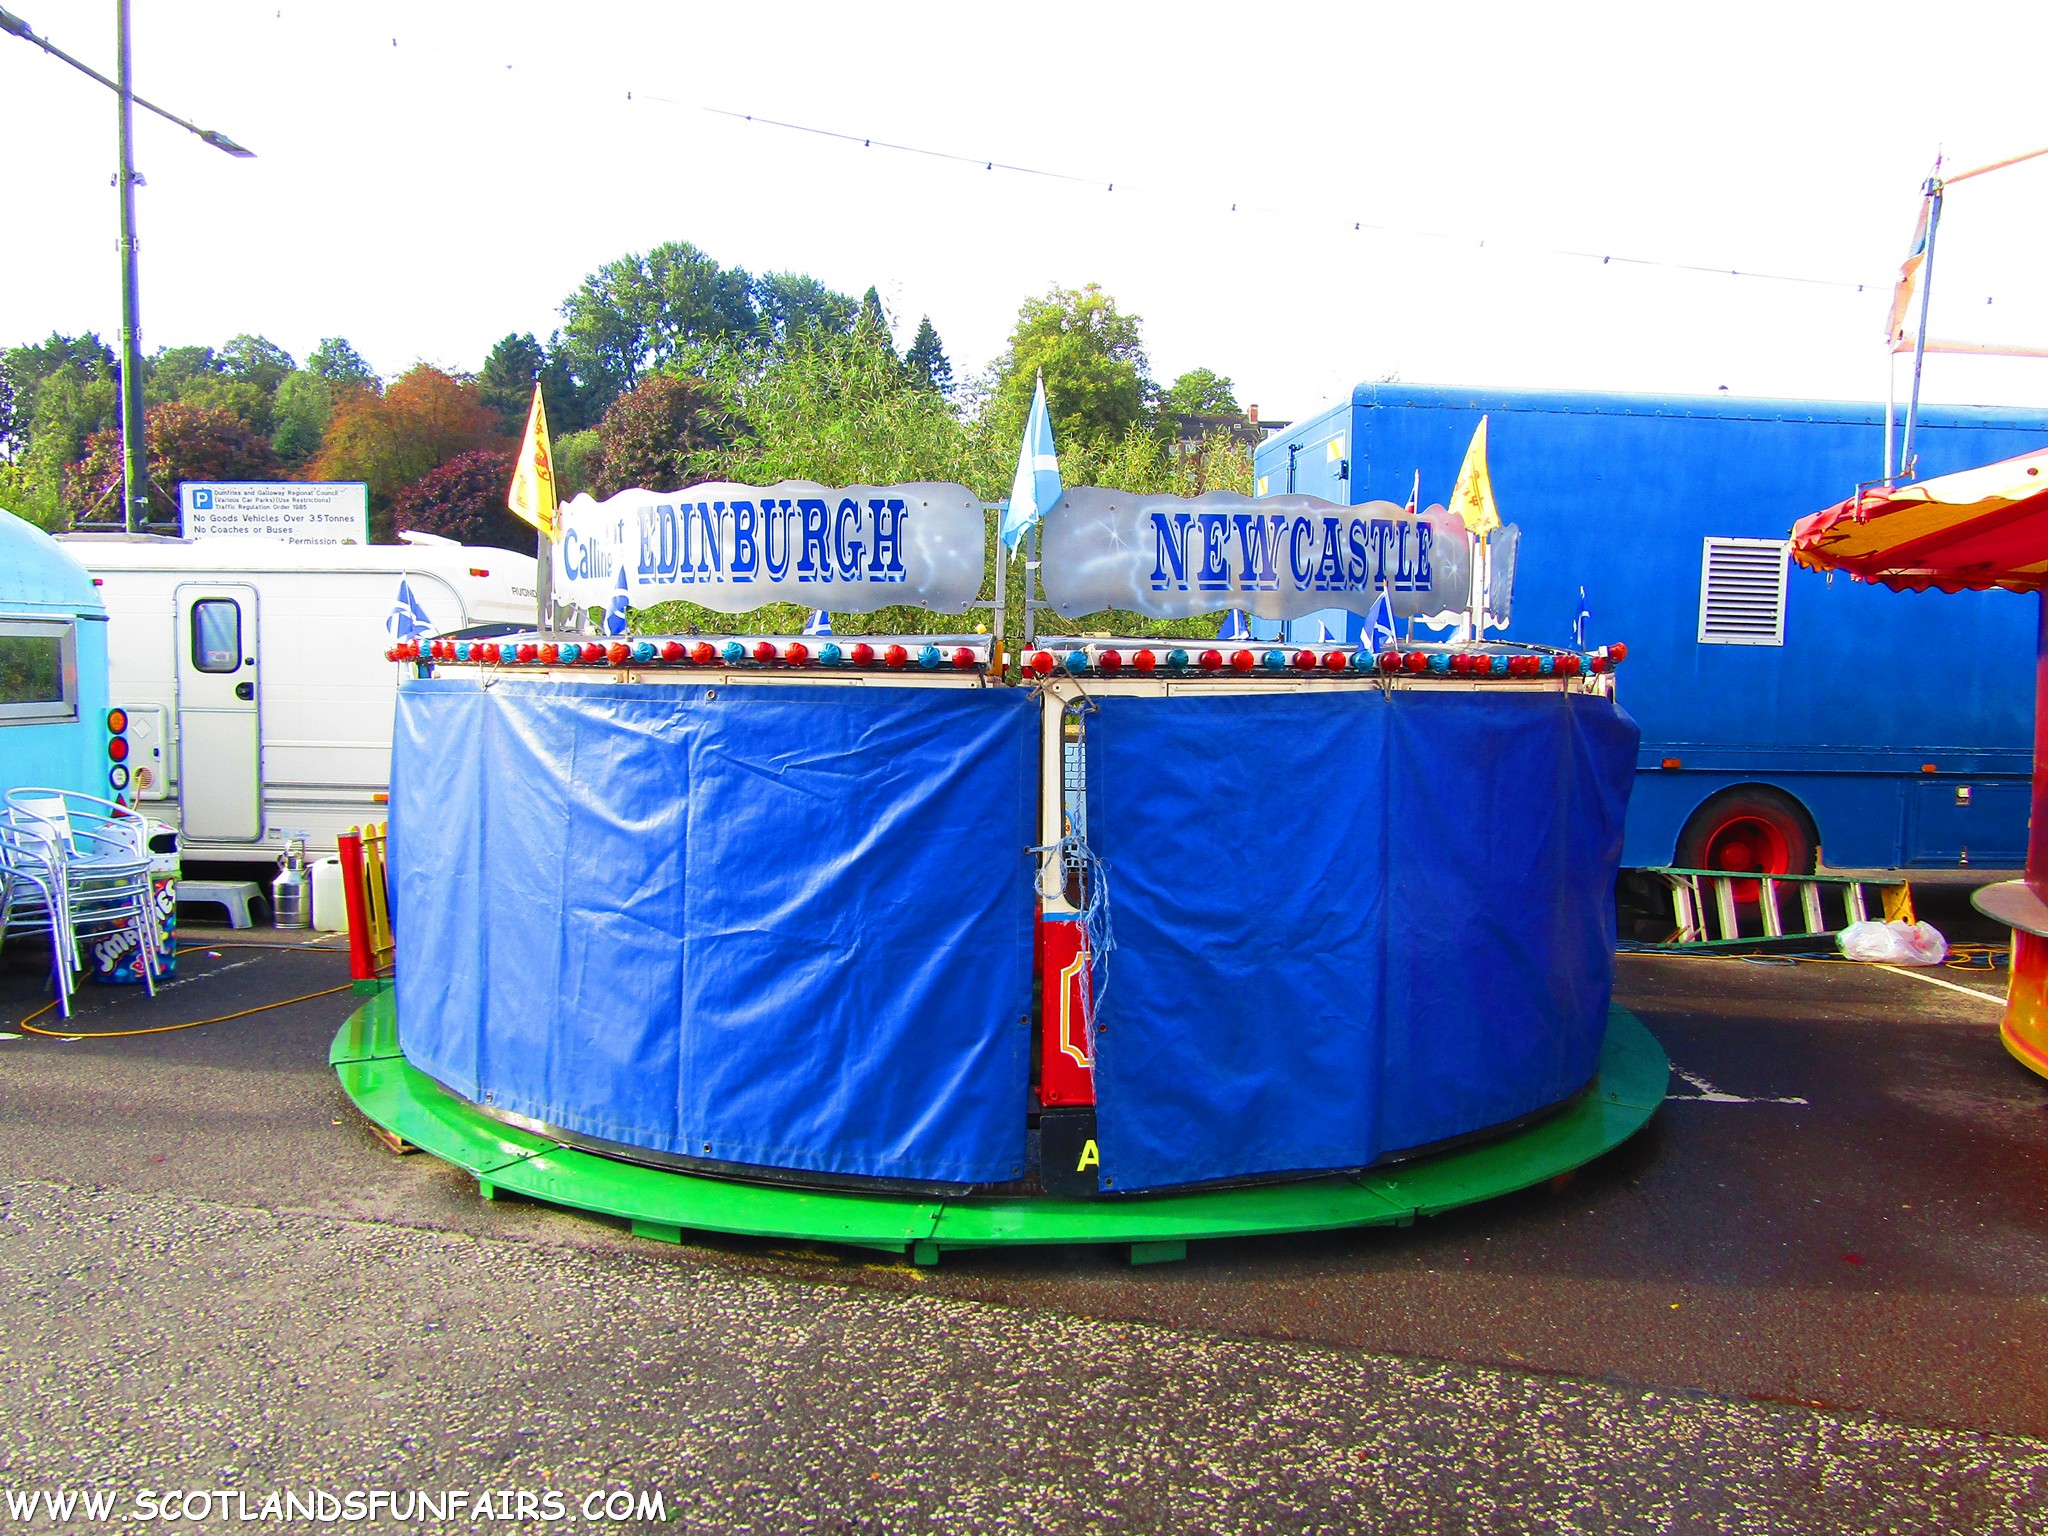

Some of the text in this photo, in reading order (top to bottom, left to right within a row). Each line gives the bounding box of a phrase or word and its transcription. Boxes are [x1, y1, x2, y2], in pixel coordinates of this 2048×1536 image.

[196, 491, 208, 507] P
[193, 515, 206, 523] No
[210, 515, 238, 523] Goods
[242, 515, 280, 523] Vehicles
[284, 515, 305, 523] Over
[194, 526, 206, 534] No
[210, 526, 249, 534] Coaches
[266, 526, 293, 534] Buses
[288, 537, 338, 545] Permission
[637, 497, 909, 584] EDINBURGH
[1150, 512, 1435, 592] NEWCASTLE
